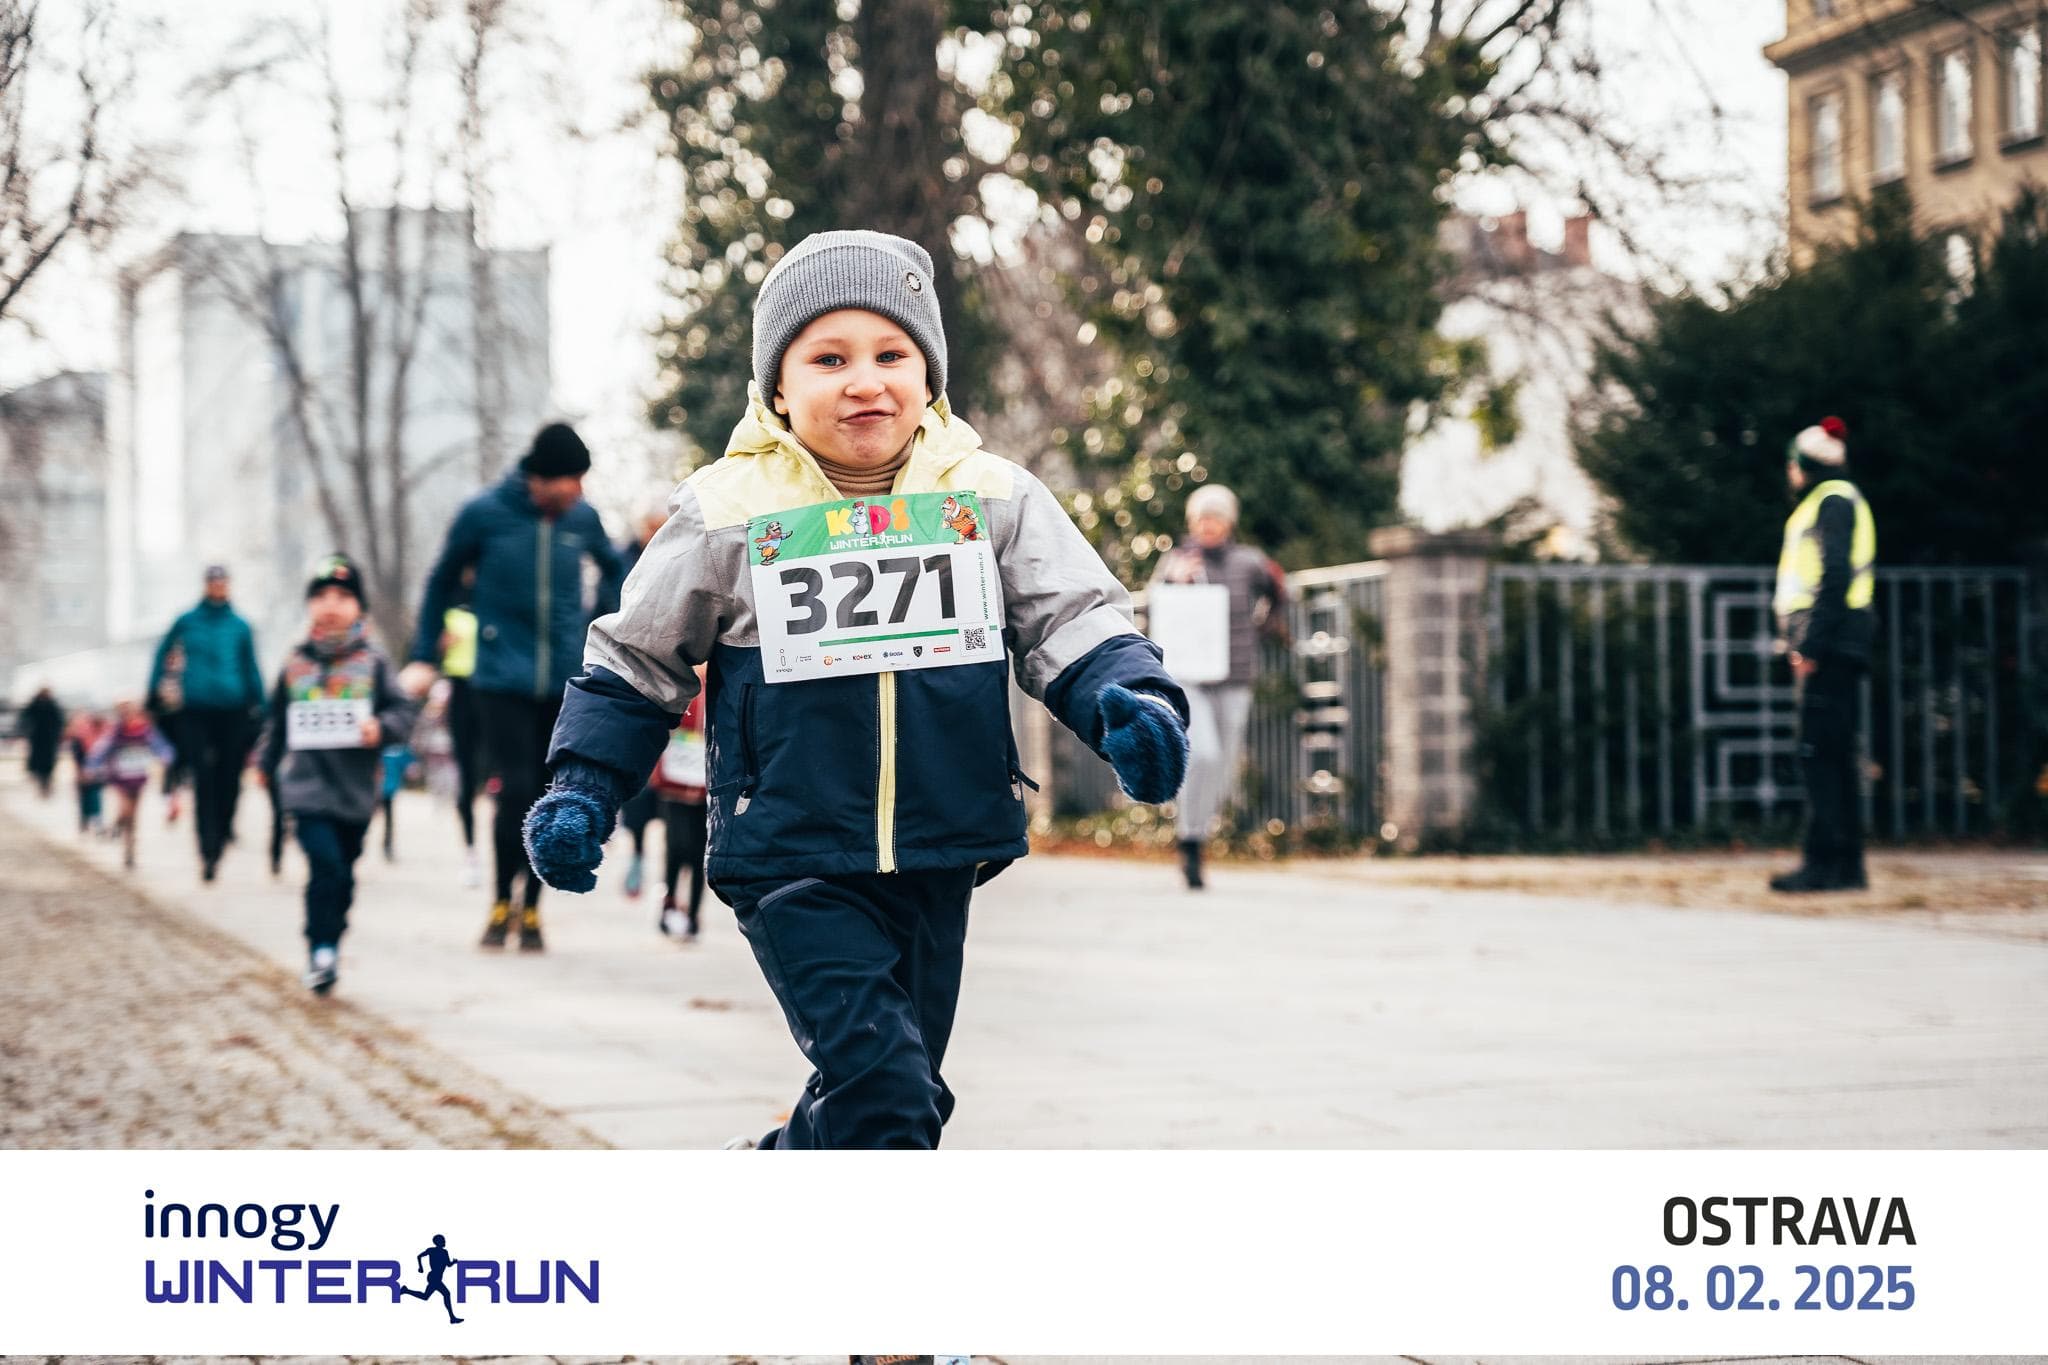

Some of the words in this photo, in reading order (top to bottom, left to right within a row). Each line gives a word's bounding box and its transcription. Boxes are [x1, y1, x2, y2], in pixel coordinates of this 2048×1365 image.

[829, 536, 878, 551] WINTER
[887, 533, 913, 545] RUN
[779, 553, 956, 636] 3271
